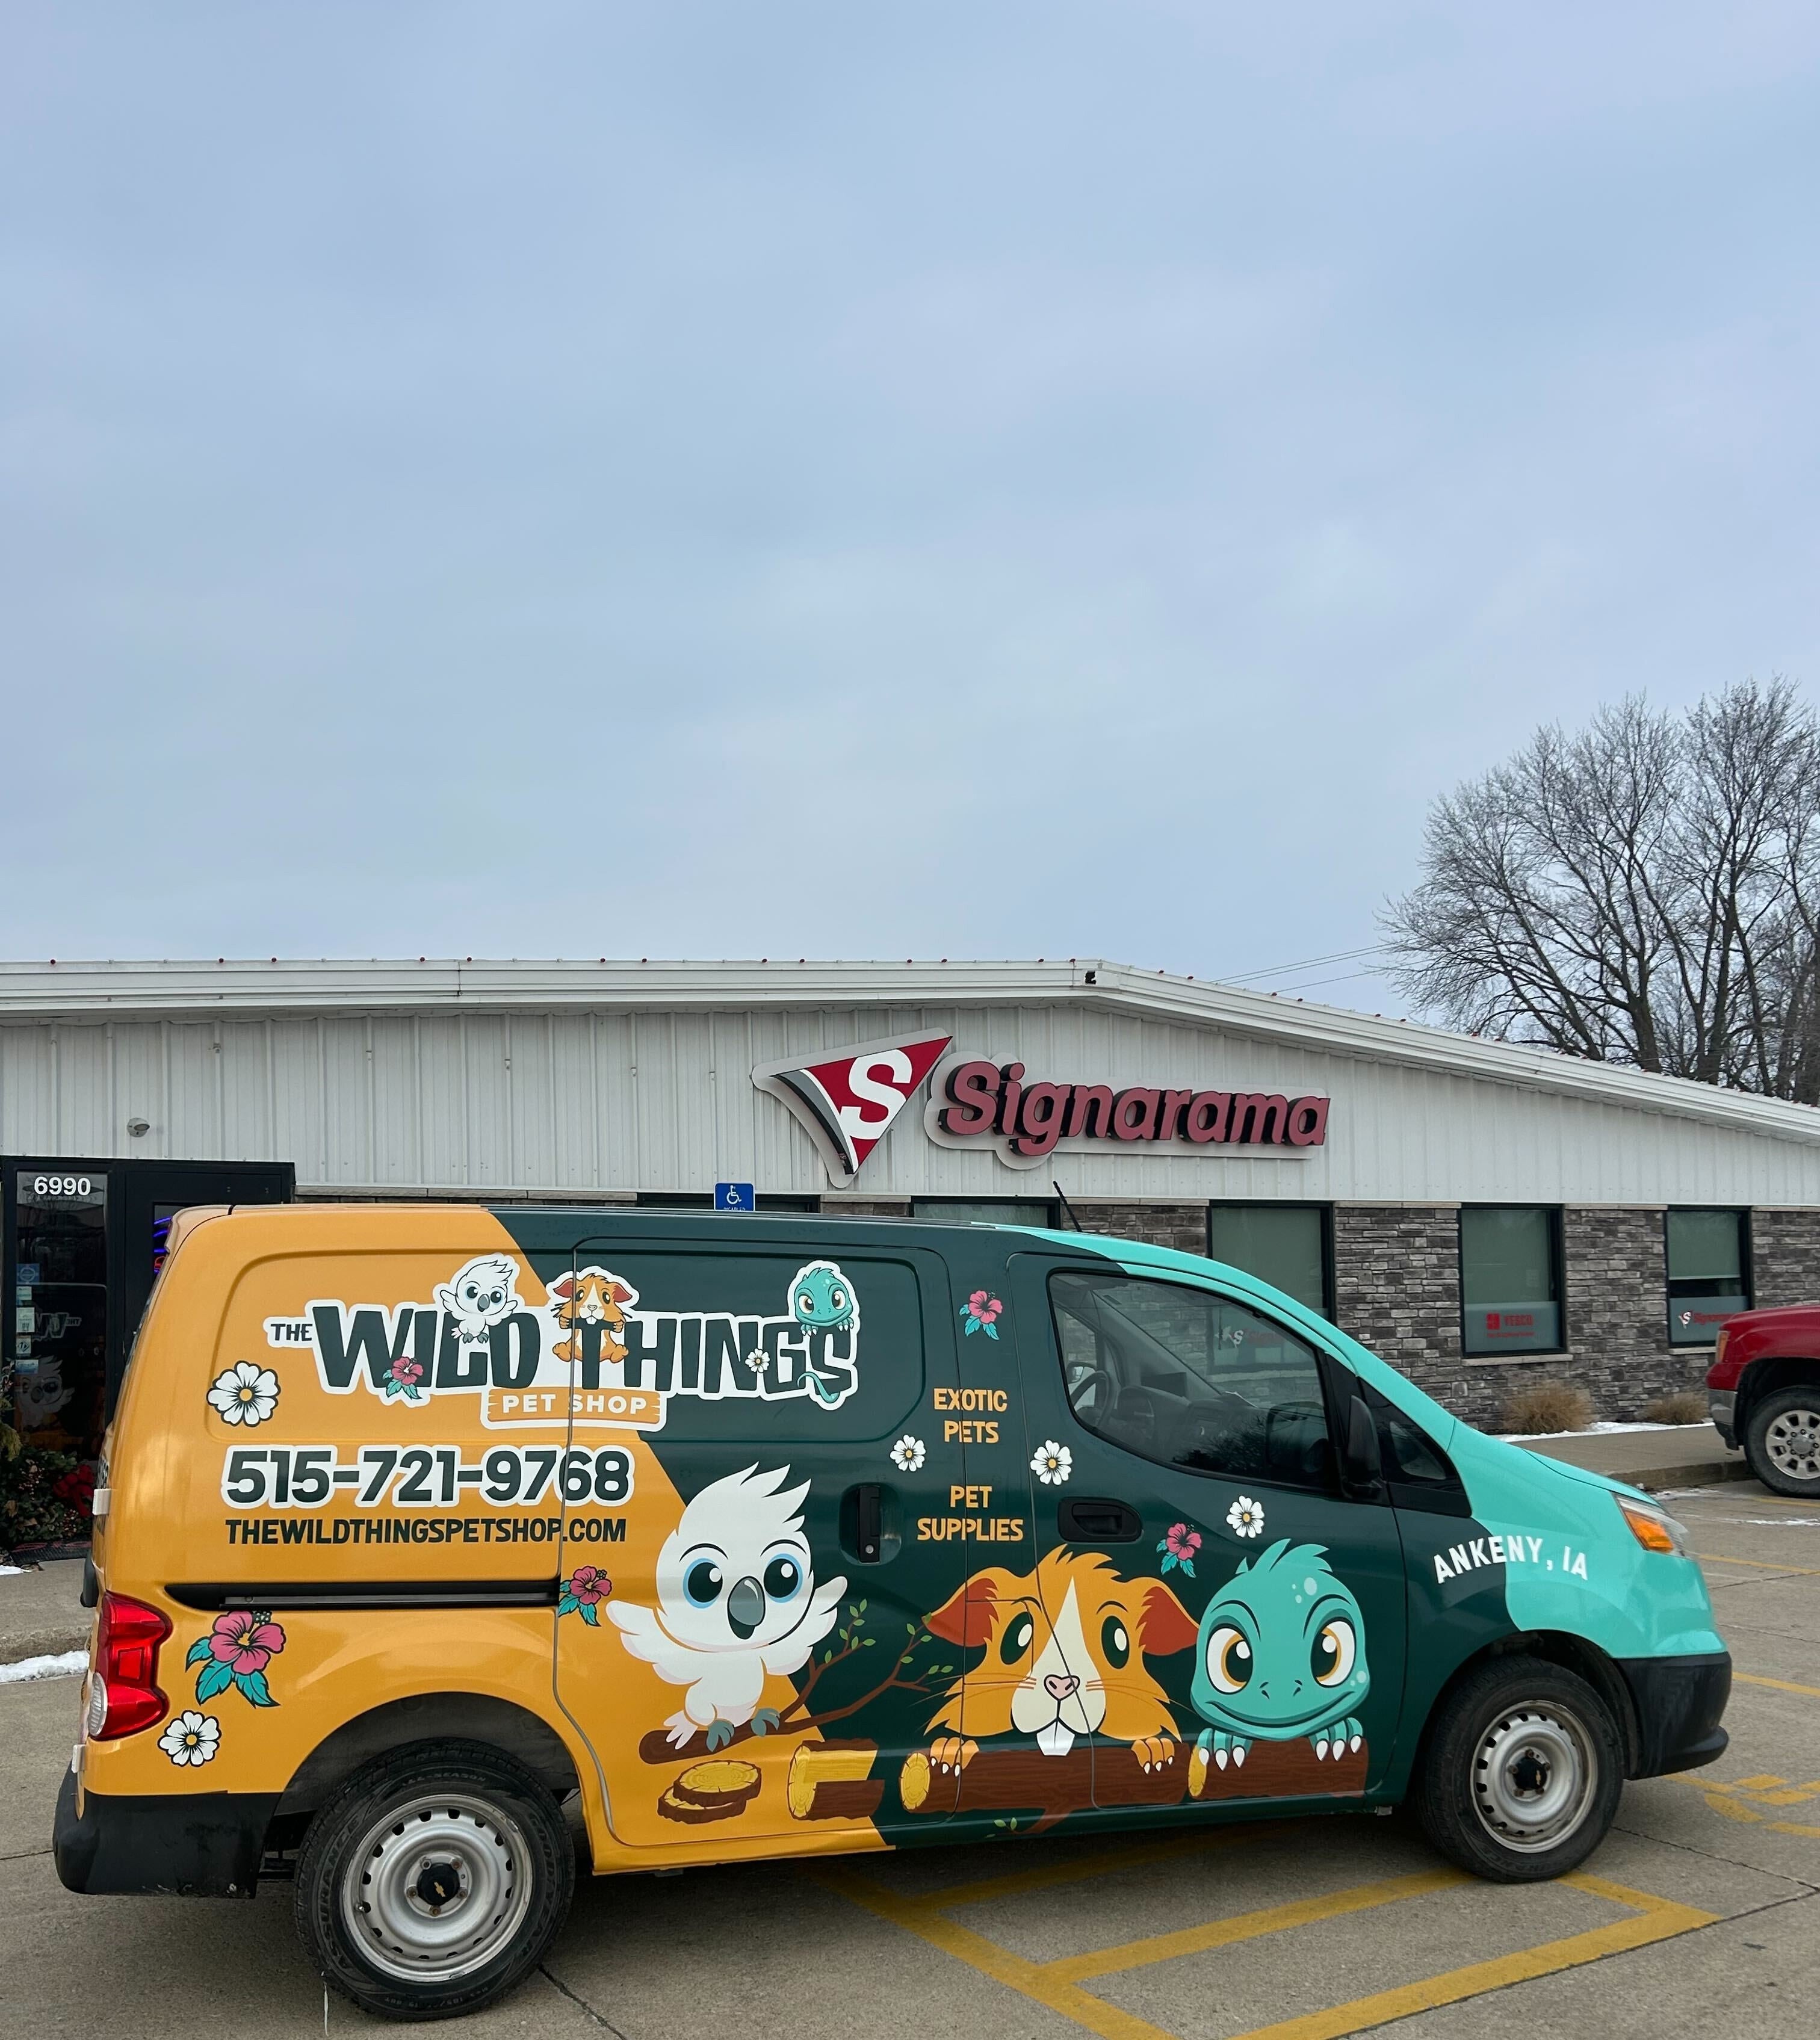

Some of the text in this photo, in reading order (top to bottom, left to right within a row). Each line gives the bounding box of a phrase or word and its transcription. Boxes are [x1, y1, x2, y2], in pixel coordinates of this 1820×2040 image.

[841, 1049, 912, 1140] S
[939, 1061, 1330, 1157] Signarama
[34, 1176, 91, 1196] 6990
[270, 1306, 852, 1395] THE WILD THINGS
[502, 1394, 648, 1415] PET SHOP
[933, 1388, 1008, 1412] EXOTIC
[944, 1420, 999, 1444] PETS
[226, 1450, 630, 1503] 515-721-9768
[950, 1486, 992, 1508] PET
[225, 1518, 626, 1545] THEWILDTHINGSPETSHOP.COM
[917, 1518, 1023, 1542] SUPPLIES
[1434, 1535, 1588, 1584] ANKENY, IA
